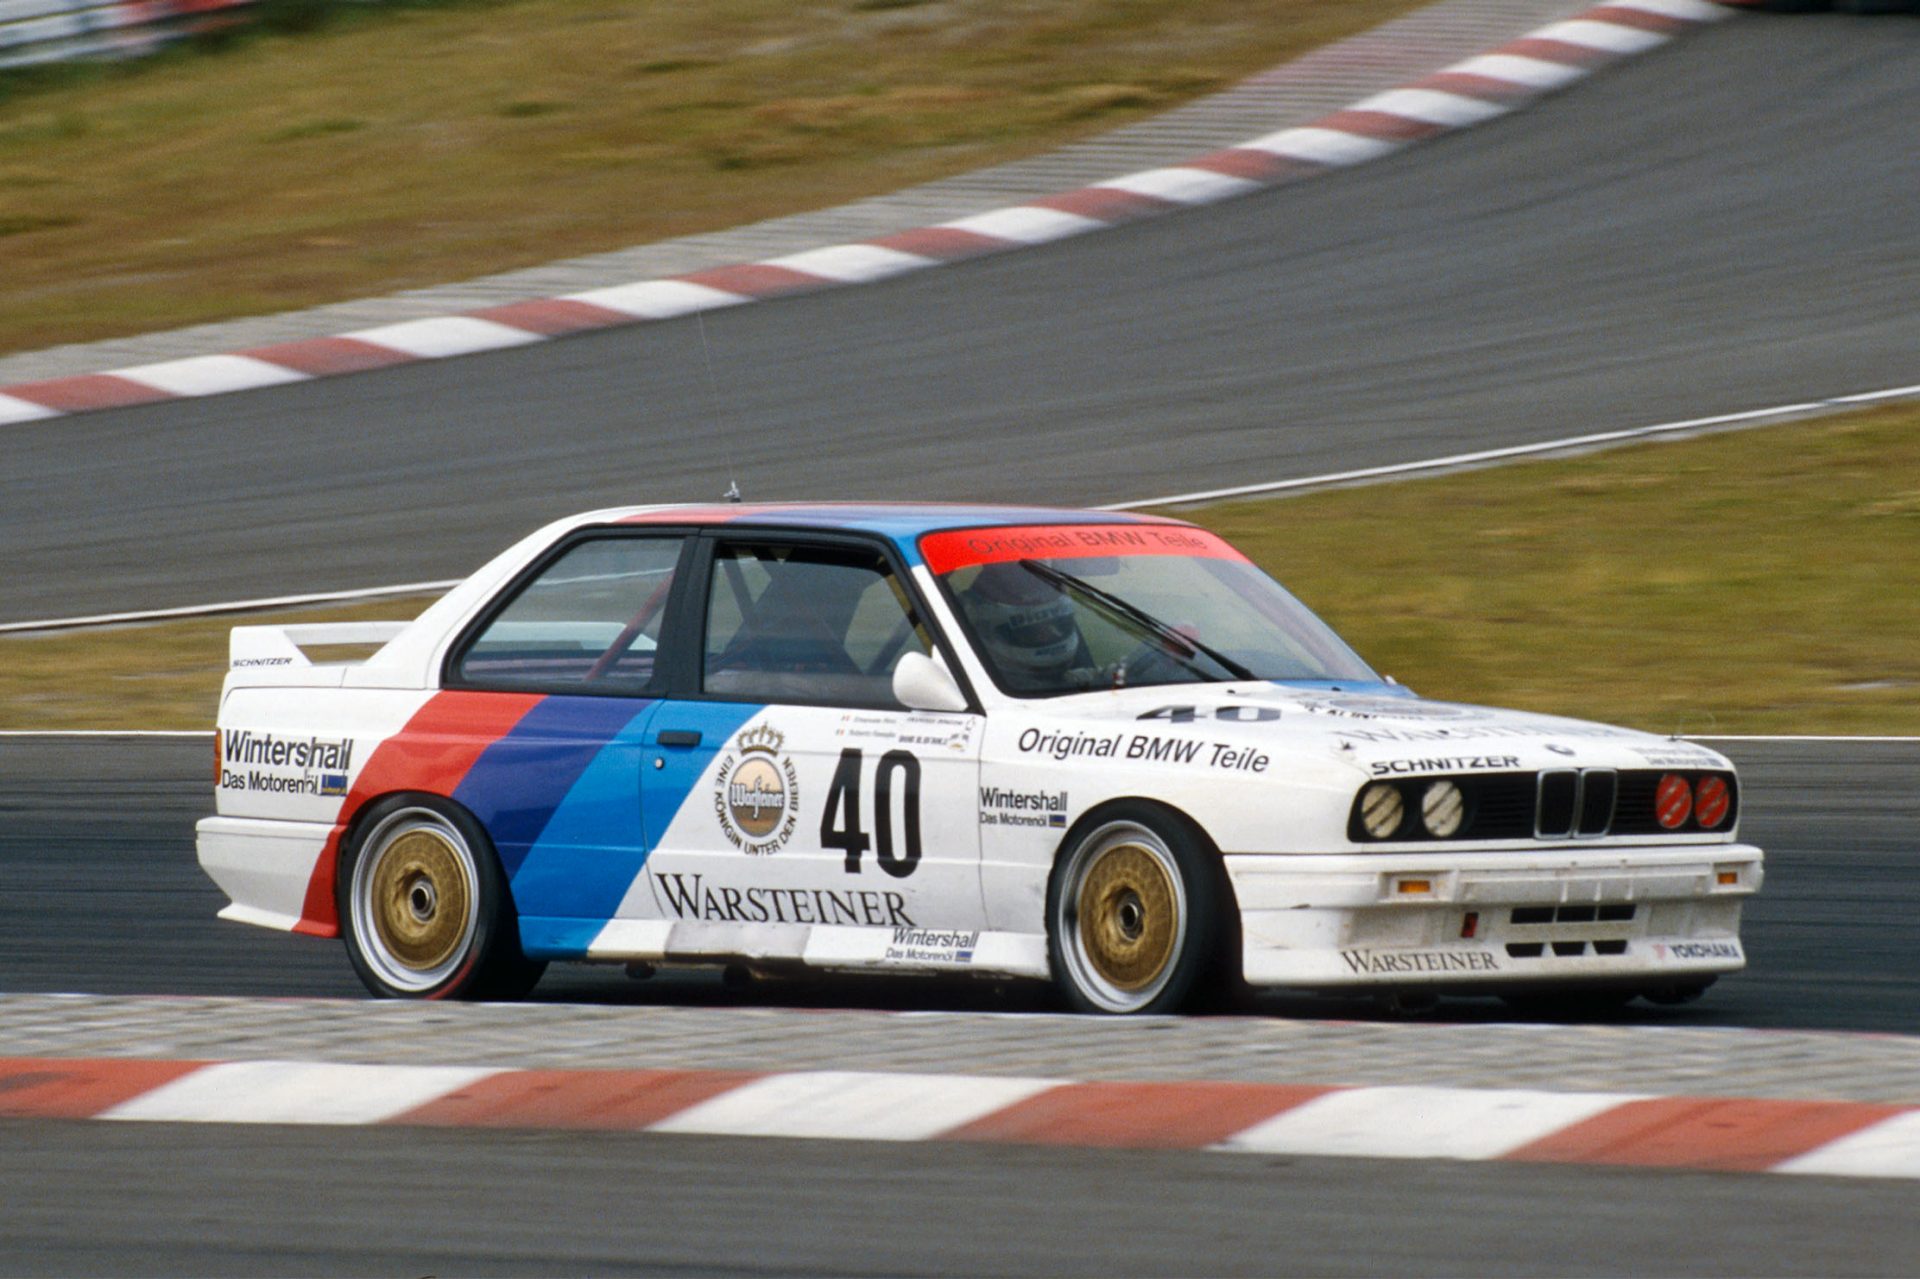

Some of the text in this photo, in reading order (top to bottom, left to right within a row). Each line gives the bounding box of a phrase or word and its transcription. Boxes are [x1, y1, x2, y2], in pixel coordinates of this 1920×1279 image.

[968, 530, 1206, 554] Original BMW Teile
[232, 657, 293, 667] SCHNITZER
[225, 729, 354, 770] Wintershall
[1018, 728, 1271, 773] Original BMW Teile
[1371, 756, 1520, 776] SCHNITZER
[222, 769, 246, 789] Das
[249, 771, 319, 794] Motorenöl
[715, 755, 734, 787] EINE
[744, 840, 781, 855] UNTER
[779, 815, 797, 844] DEN
[980, 787, 1068, 811] Wintershall
[820, 748, 922, 878] 40
[980, 811, 997, 824] Das
[654, 873, 917, 927] WARSTEINER
[893, 928, 980, 949] Wintershall
[1342, 950, 1499, 974] WARSTEINER
